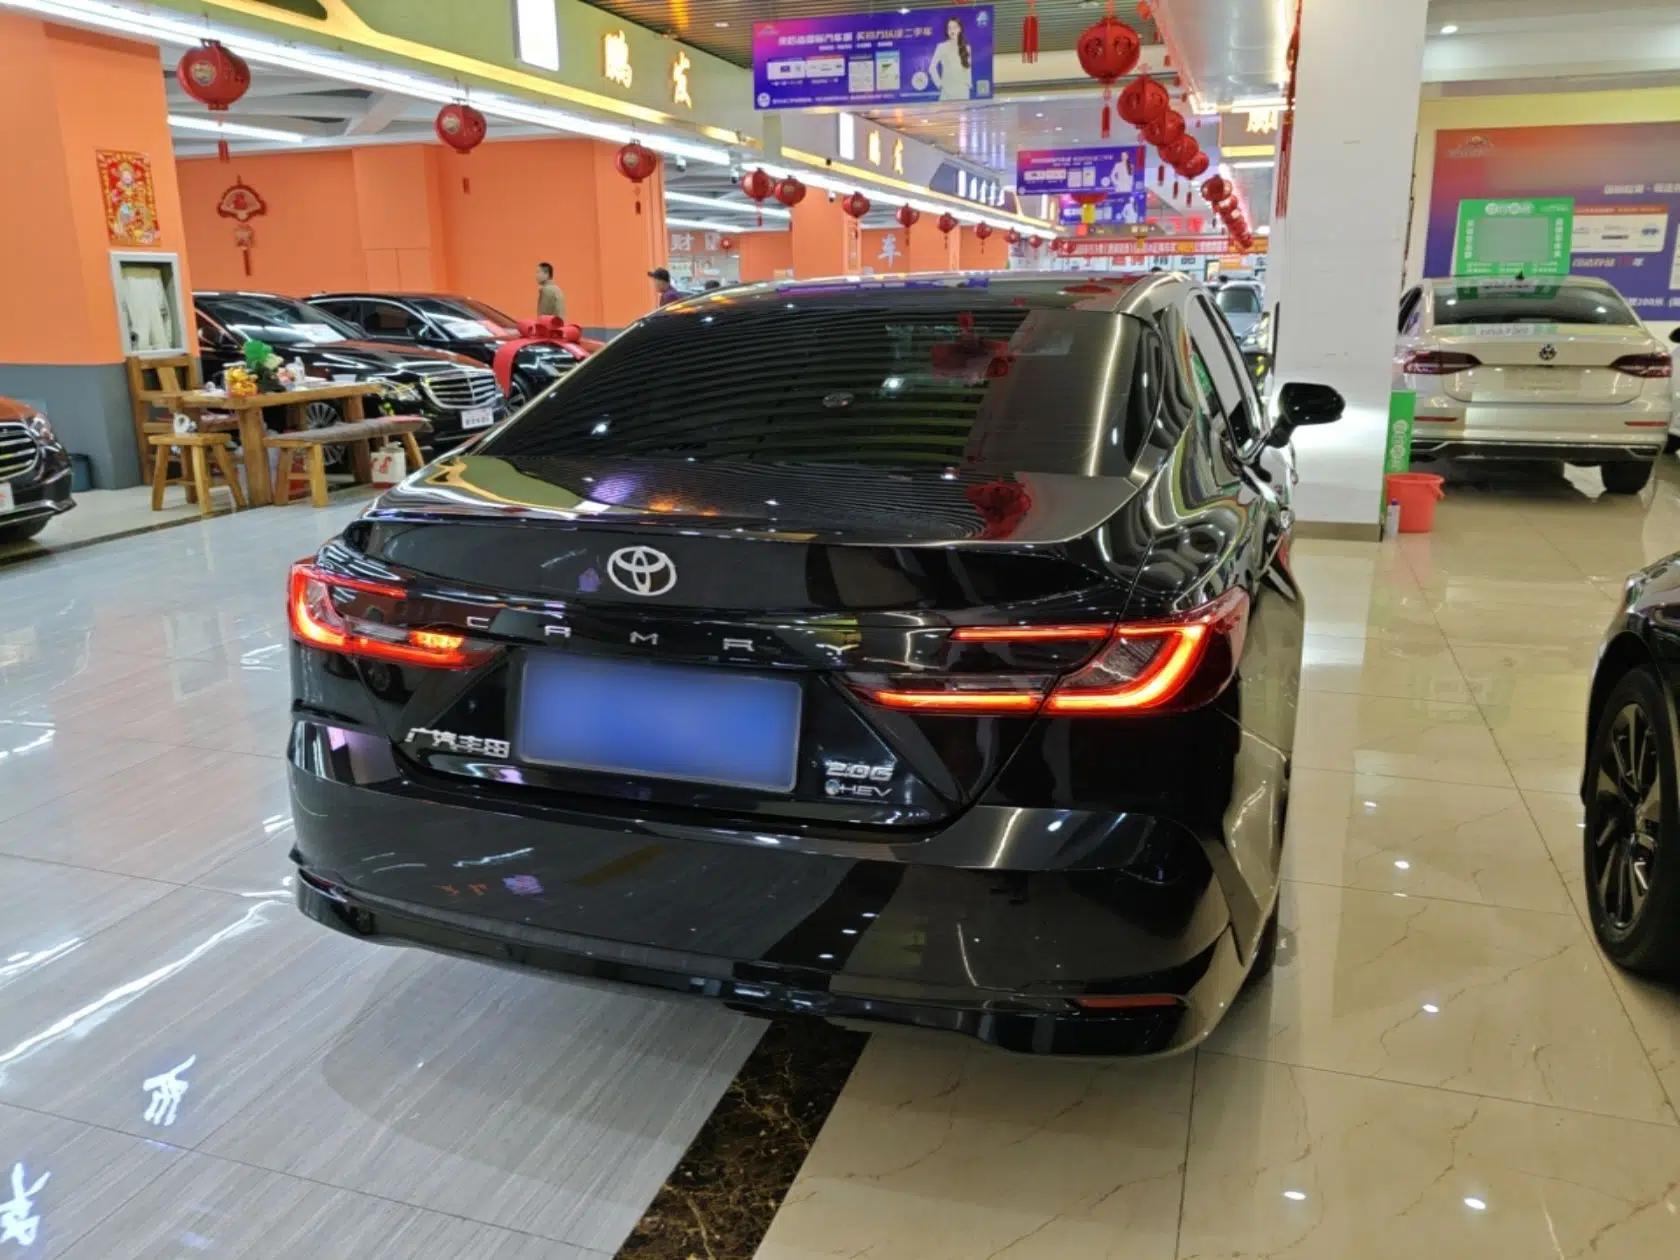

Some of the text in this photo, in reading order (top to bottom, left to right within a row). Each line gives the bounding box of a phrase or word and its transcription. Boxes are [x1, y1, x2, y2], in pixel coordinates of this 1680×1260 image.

[466, 616, 859, 656] CAMRY
[404, 727, 511, 759] 广汽丰田
[824, 760, 895, 782] 2.0G
